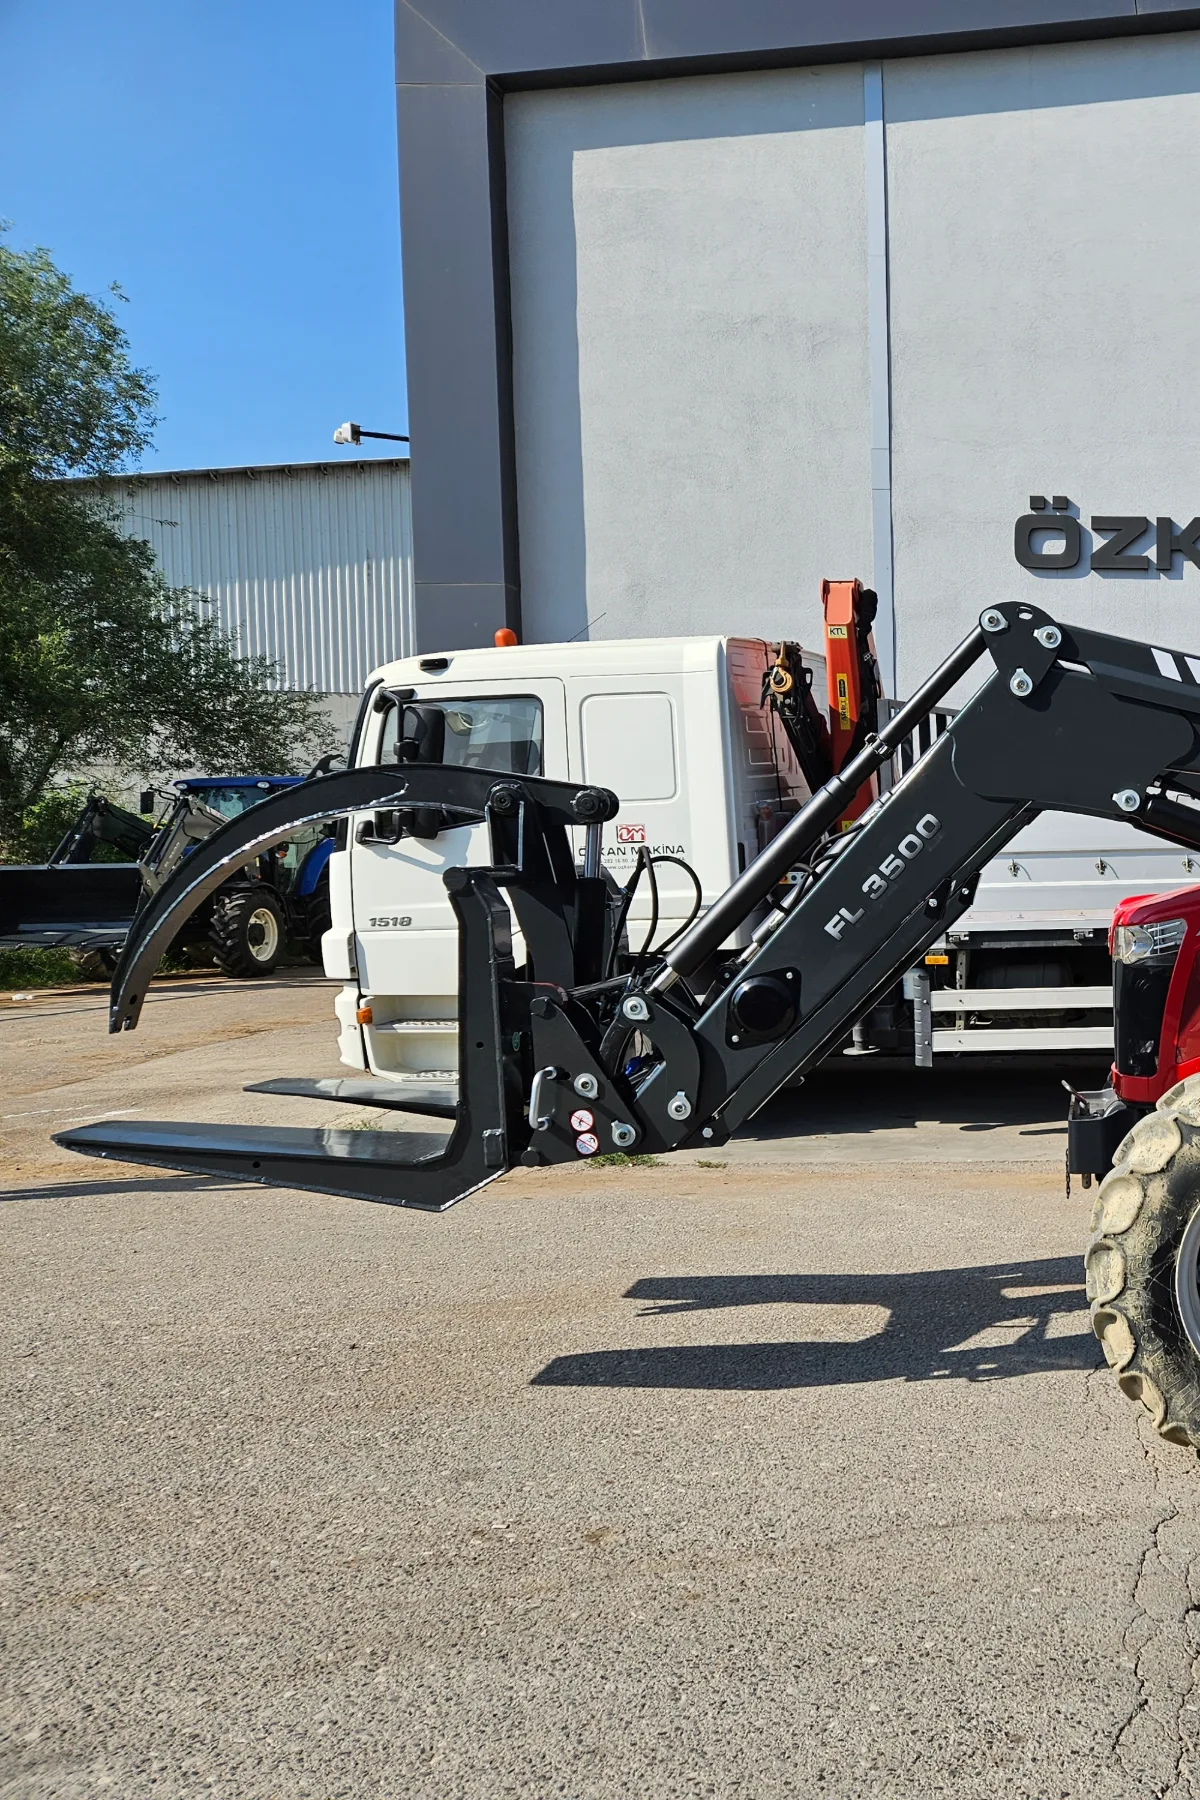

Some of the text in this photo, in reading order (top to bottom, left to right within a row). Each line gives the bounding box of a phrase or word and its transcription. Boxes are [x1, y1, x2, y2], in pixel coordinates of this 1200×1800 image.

[578, 845, 626, 857] ÖAN
[823, 813, 942, 941] FL 3500
[369, 916, 413, 927] 1518
